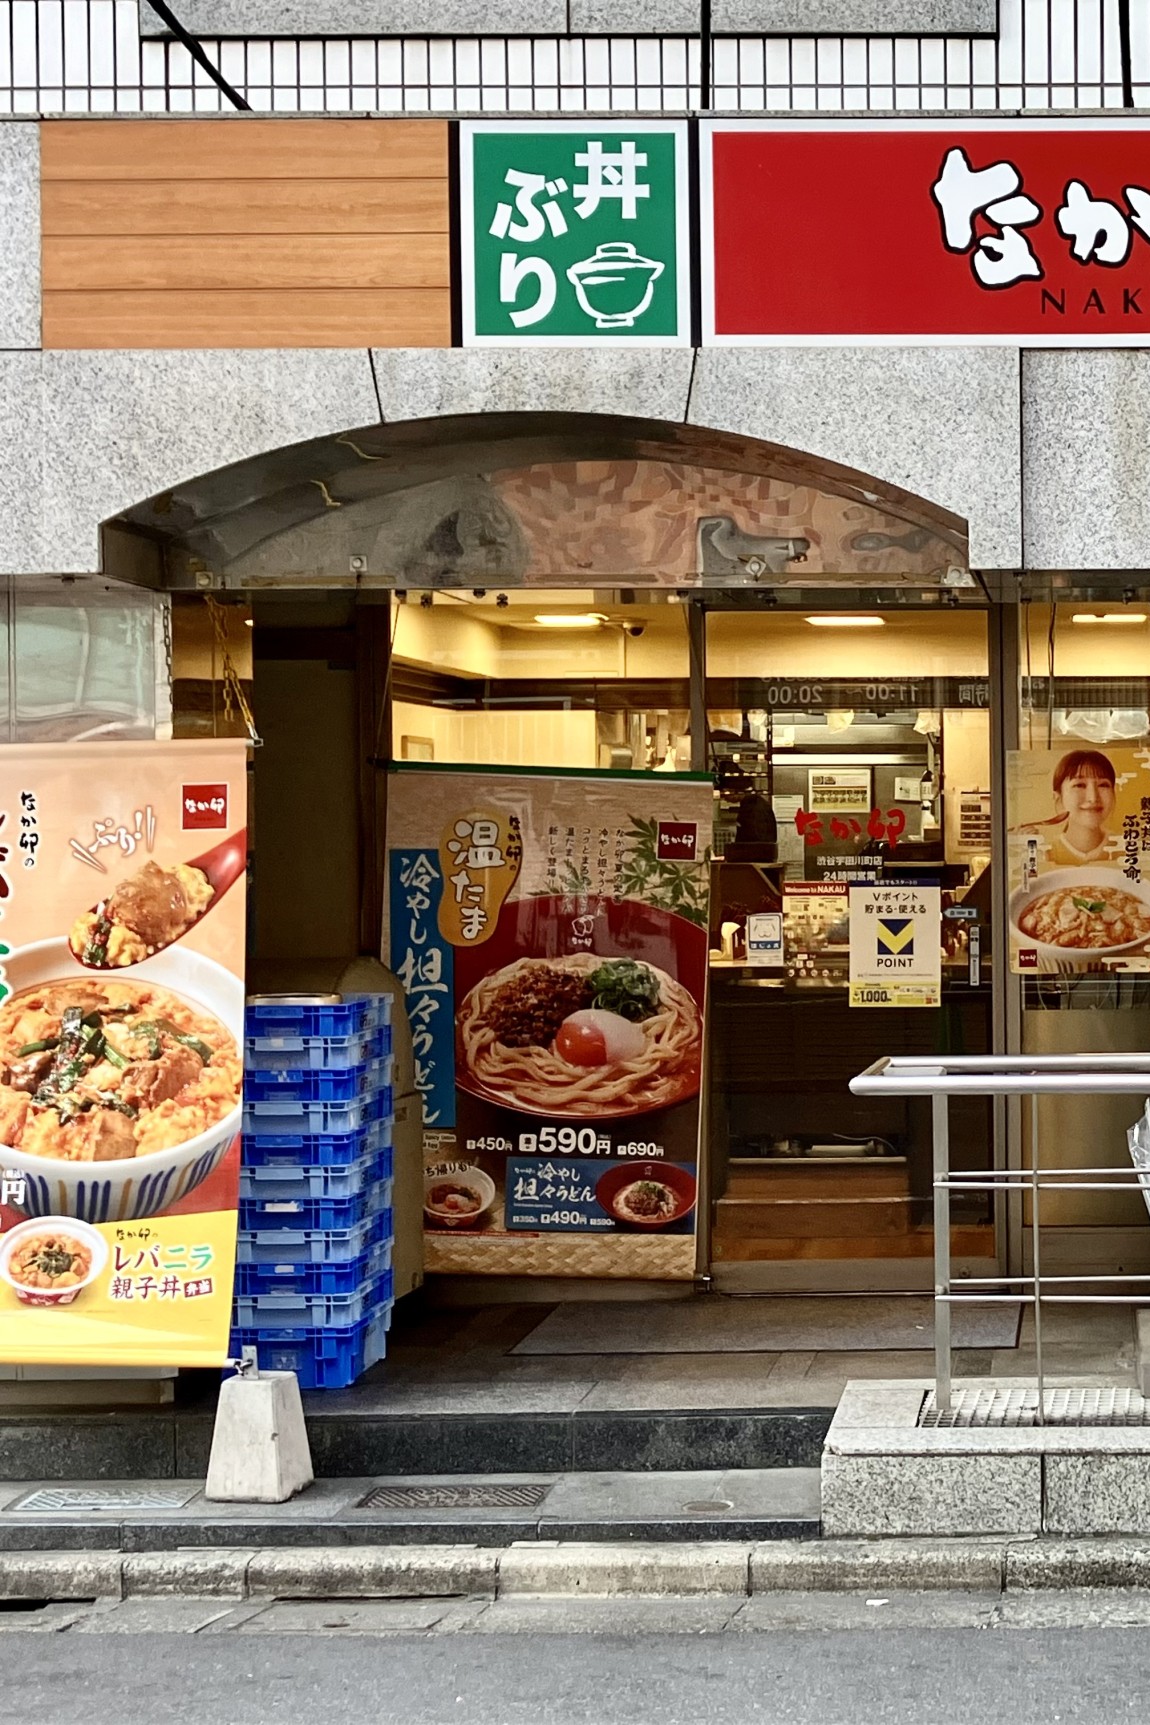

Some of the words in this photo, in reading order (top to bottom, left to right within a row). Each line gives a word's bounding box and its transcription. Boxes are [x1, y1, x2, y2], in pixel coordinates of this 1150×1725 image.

[184, 796, 225, 815] なか卯
[19, 790, 40, 868] なか卯の
[660, 832, 695, 847] なか卯
[794, 807, 906, 849] なか卯
[506, 814, 522, 872] なか卯の
[446, 818, 507, 941] 温たま
[817, 885, 847, 894] NAKAU
[872, 892, 919, 902] Vポイント
[876, 958, 914, 968] POINT
[538, 1126, 612, 1156] 590円
[537, 1162, 581, 1182] 冷やし
[513, 1177, 598, 1203] 担々うどん
[113, 1244, 214, 1272] レバニラ
[111, 1275, 182, 1300] 親子丼
[186, 1280, 212, 1298] 弁当
